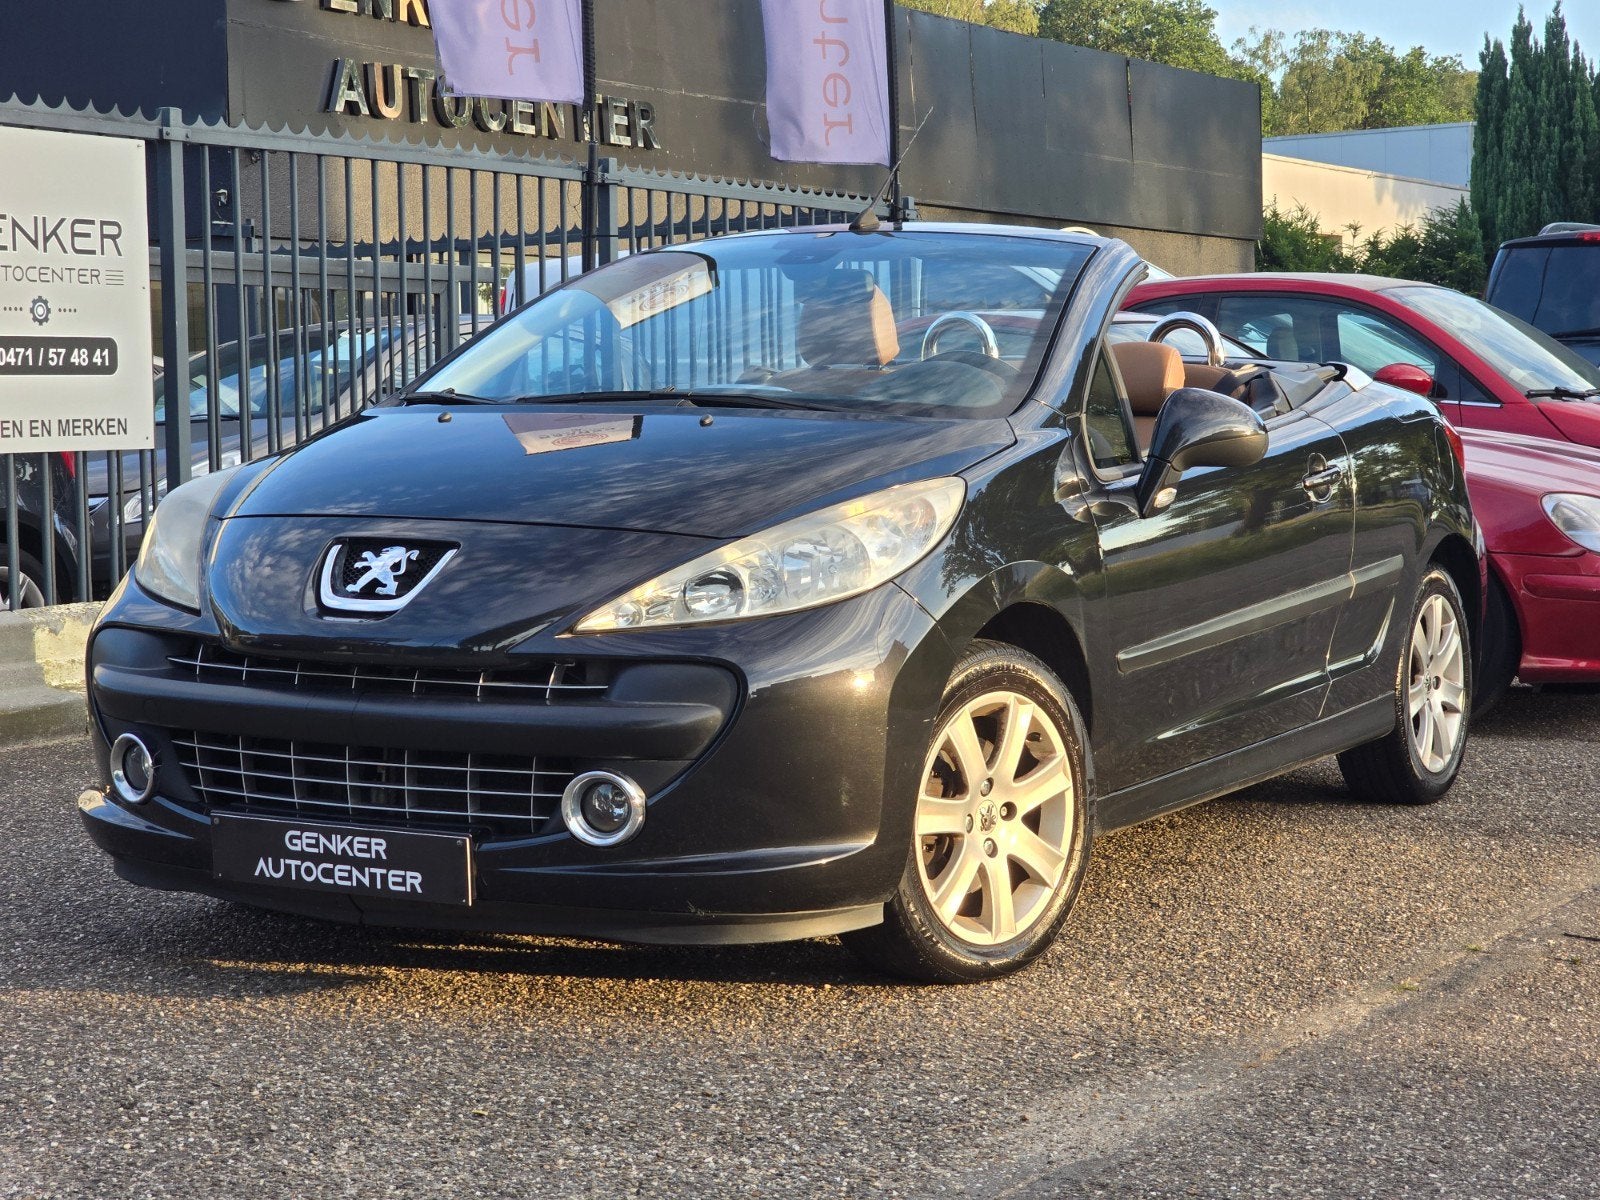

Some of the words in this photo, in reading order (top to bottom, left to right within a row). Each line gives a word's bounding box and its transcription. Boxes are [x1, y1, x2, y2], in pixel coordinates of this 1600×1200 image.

[0, 347, 33, 367] 0471
[48, 348, 66, 367] 57
[70, 348, 89, 367] 48
[92, 348, 110, 367] 41
[29, 419, 52, 438] EN
[57, 418, 128, 437] MERKEN
[284, 829, 388, 860] GENKER
[254, 856, 423, 894] AUTOCENTER
